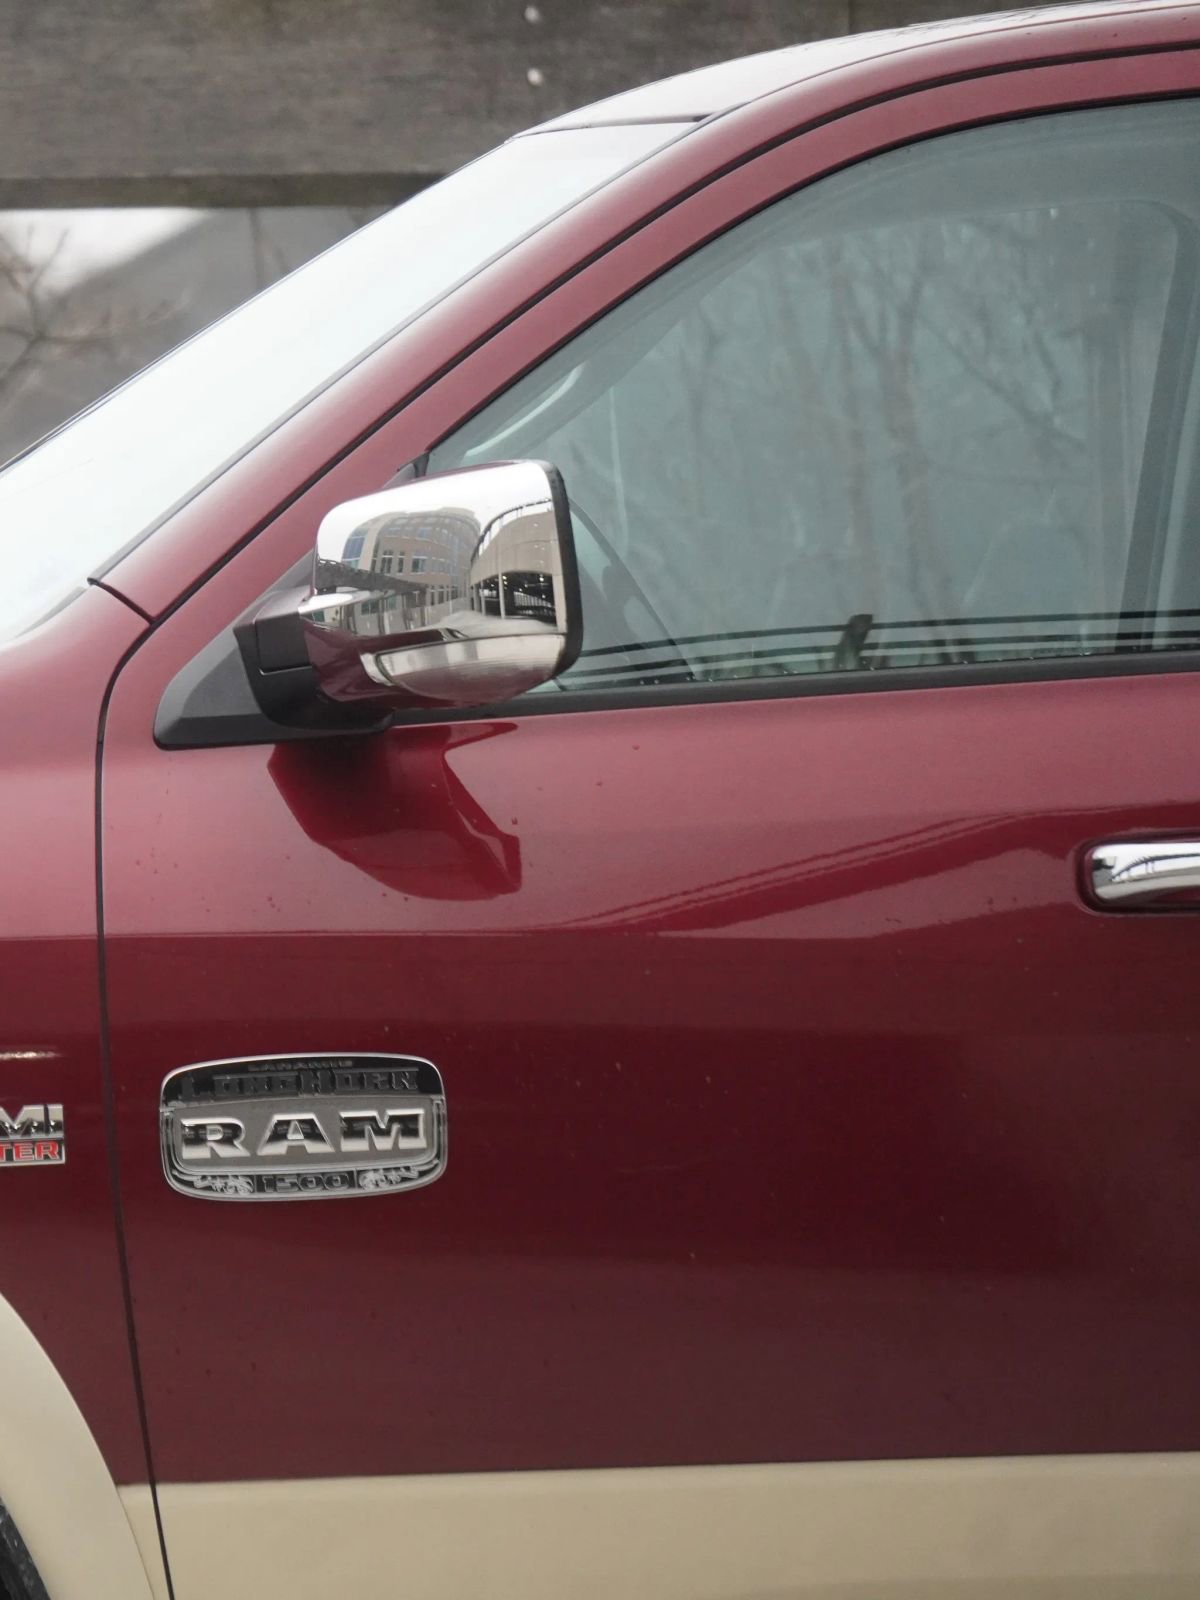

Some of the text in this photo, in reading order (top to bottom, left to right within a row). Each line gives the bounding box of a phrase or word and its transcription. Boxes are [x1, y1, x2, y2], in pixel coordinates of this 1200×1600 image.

[178, 1069, 419, 1102] LONGHORN
[181, 1108, 427, 1159] RAM
[262, 1172, 350, 1193] 1500
